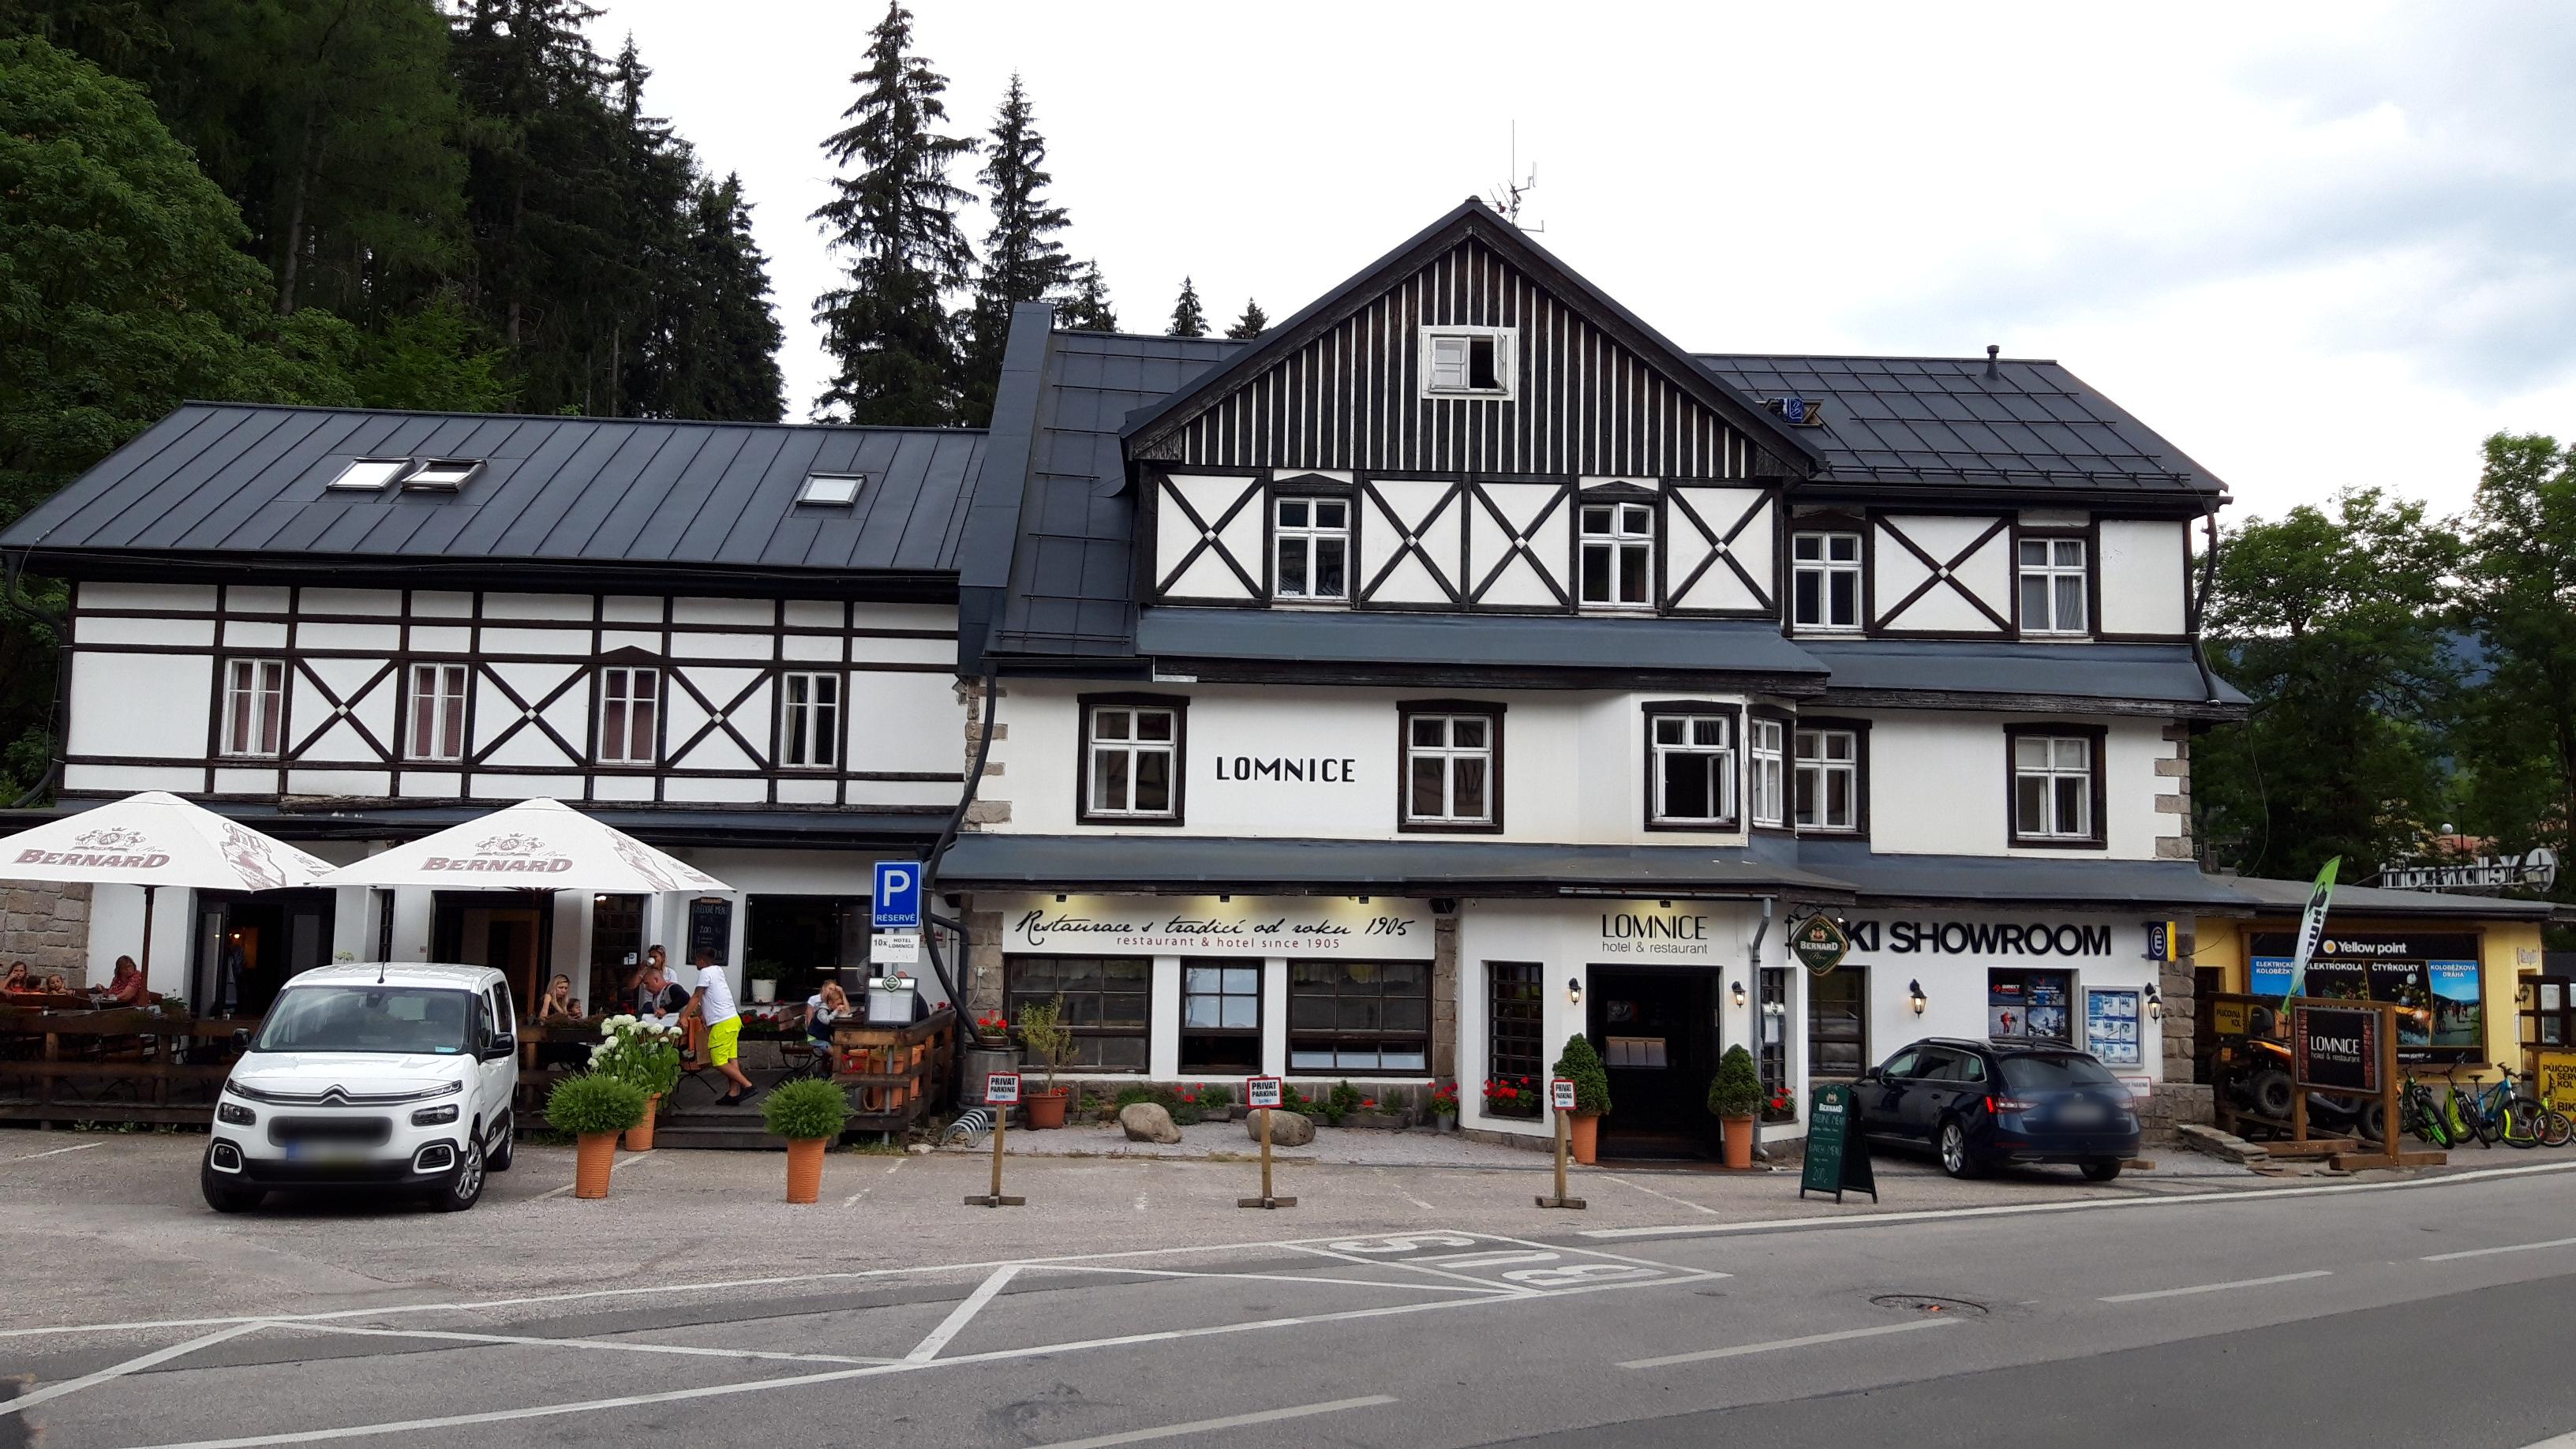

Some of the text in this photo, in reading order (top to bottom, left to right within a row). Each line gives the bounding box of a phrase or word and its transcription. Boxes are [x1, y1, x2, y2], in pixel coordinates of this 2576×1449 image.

[1216, 756, 1356, 782] LOMNICE
[11, 848, 171, 869] BERNARD
[417, 856, 574, 874] BERNARD
[883, 870, 911, 907] P
[876, 912, 915, 922] RÉSERVÉ
[1016, 909, 1415, 946] Restaurace s tradicí od roku 1905
[1602, 914, 1709, 940] LOMNICE
[1118, 937, 1340, 948] restaurant & hotel since 1905
[1842, 920, 2112, 957] KI SHOWROOM
[1602, 941, 1709, 954] hotel & restaurant
[1800, 941, 1839, 951] BERNARD
[2338, 941, 2407, 955] Yellow point
[2372, 962, 2420, 972] ČTYŘKOLKY
[2310, 1035, 2360, 1055] LOMNICE
[2332, 1054, 2361, 1063] restaurant
[1252, 1081, 1277, 1090] PRIVAT
[1556, 1084, 1572, 1092] PRIVAT
[2557, 1080, 2574, 1089] KOL
[1818, 1103, 1843, 1113] BERNARD
